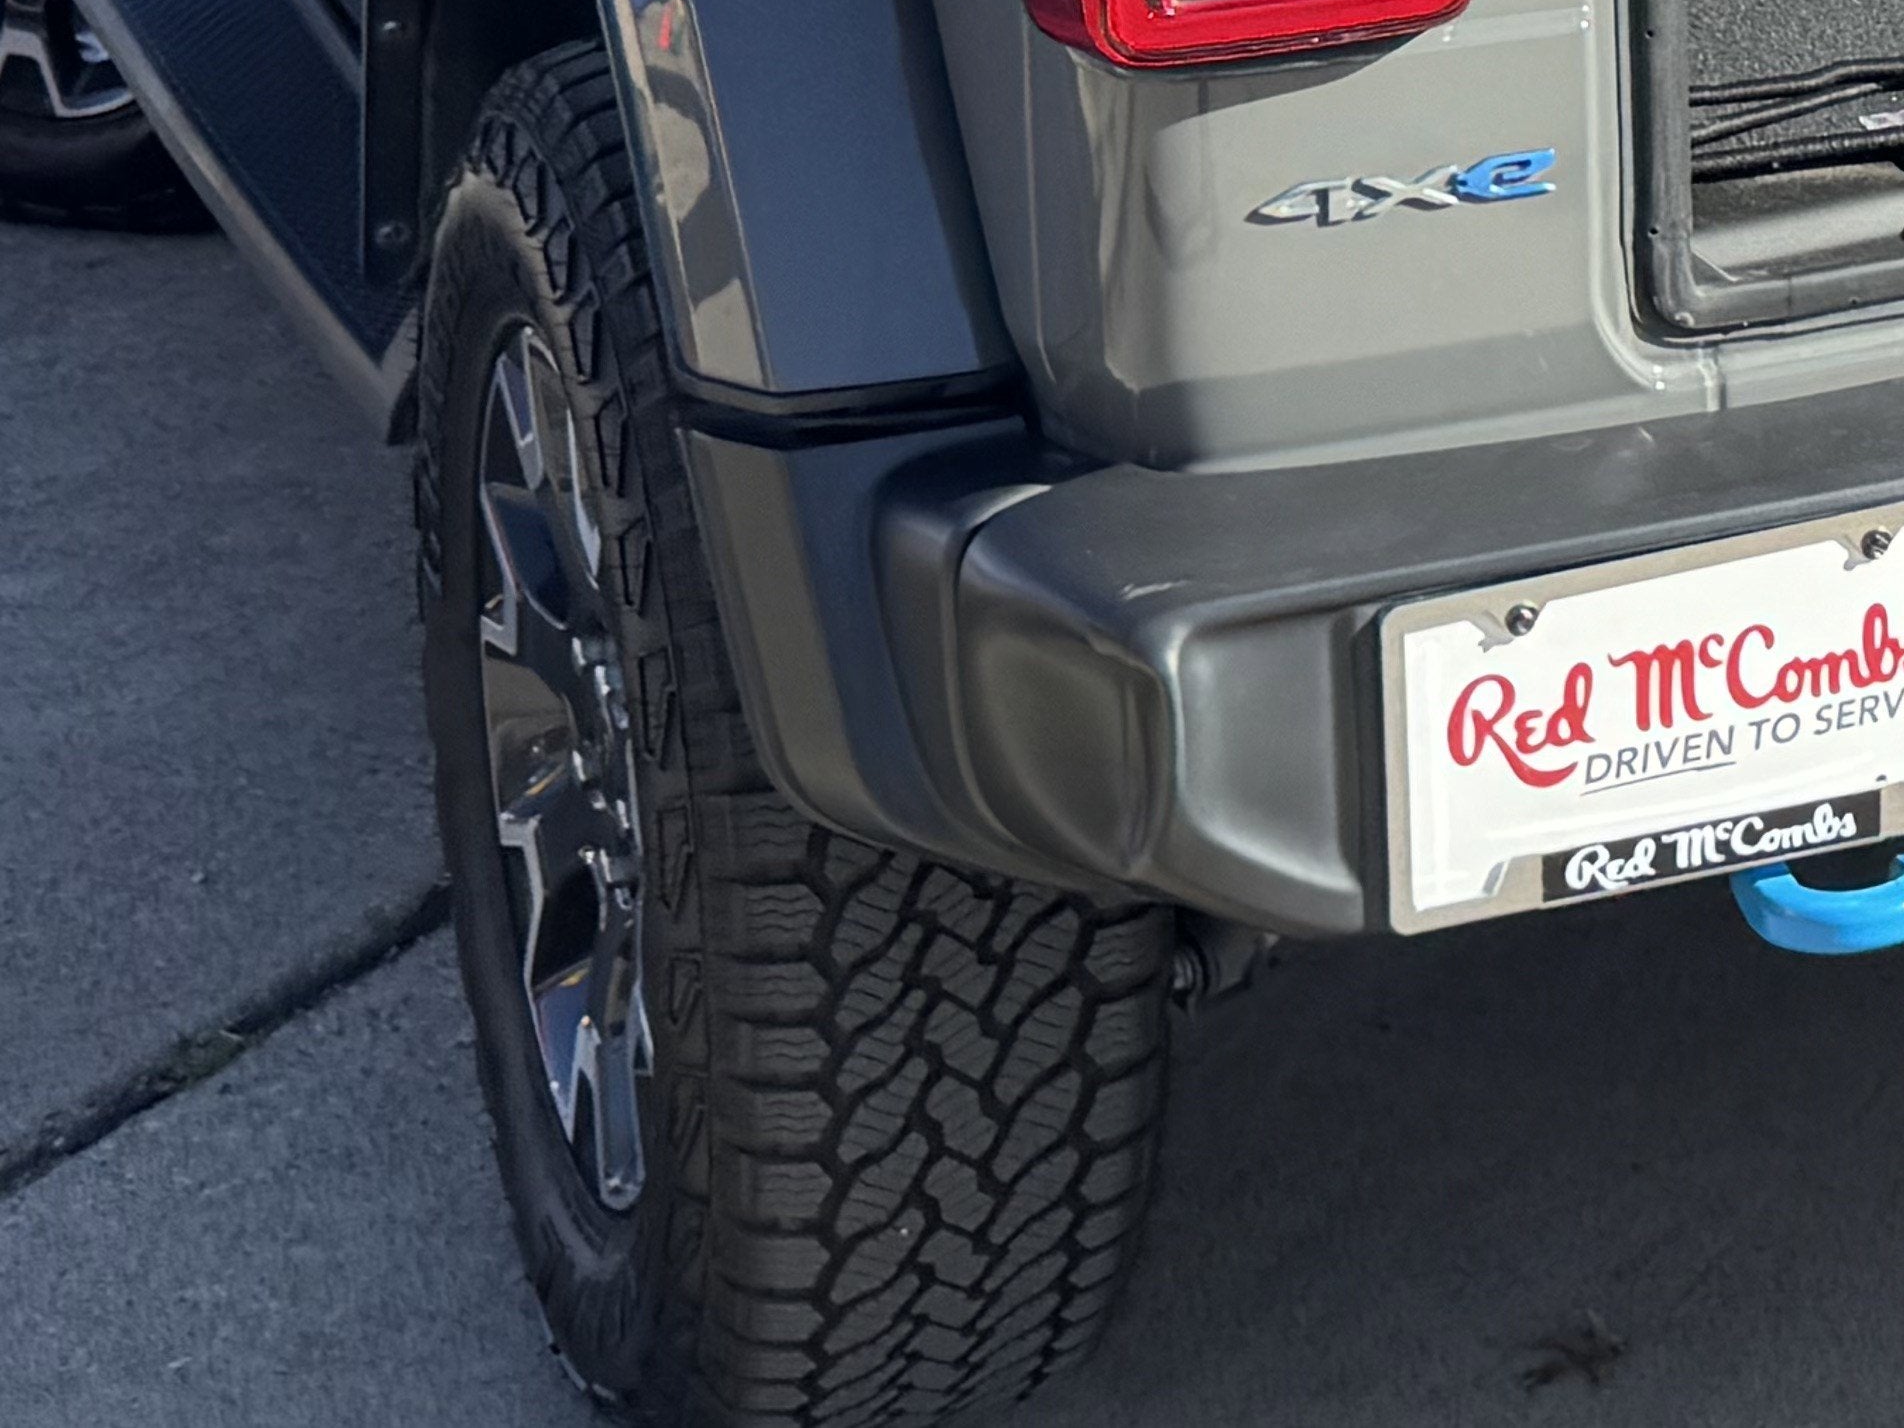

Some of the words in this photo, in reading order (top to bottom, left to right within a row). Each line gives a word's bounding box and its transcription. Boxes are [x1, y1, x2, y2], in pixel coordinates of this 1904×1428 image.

[1446, 661, 1596, 788] Red
[1585, 724, 1737, 786] DRIVEN
[1748, 713, 1801, 752] TO
[1564, 840, 1657, 891] Red
[1662, 802, 1858, 871] McCombs
